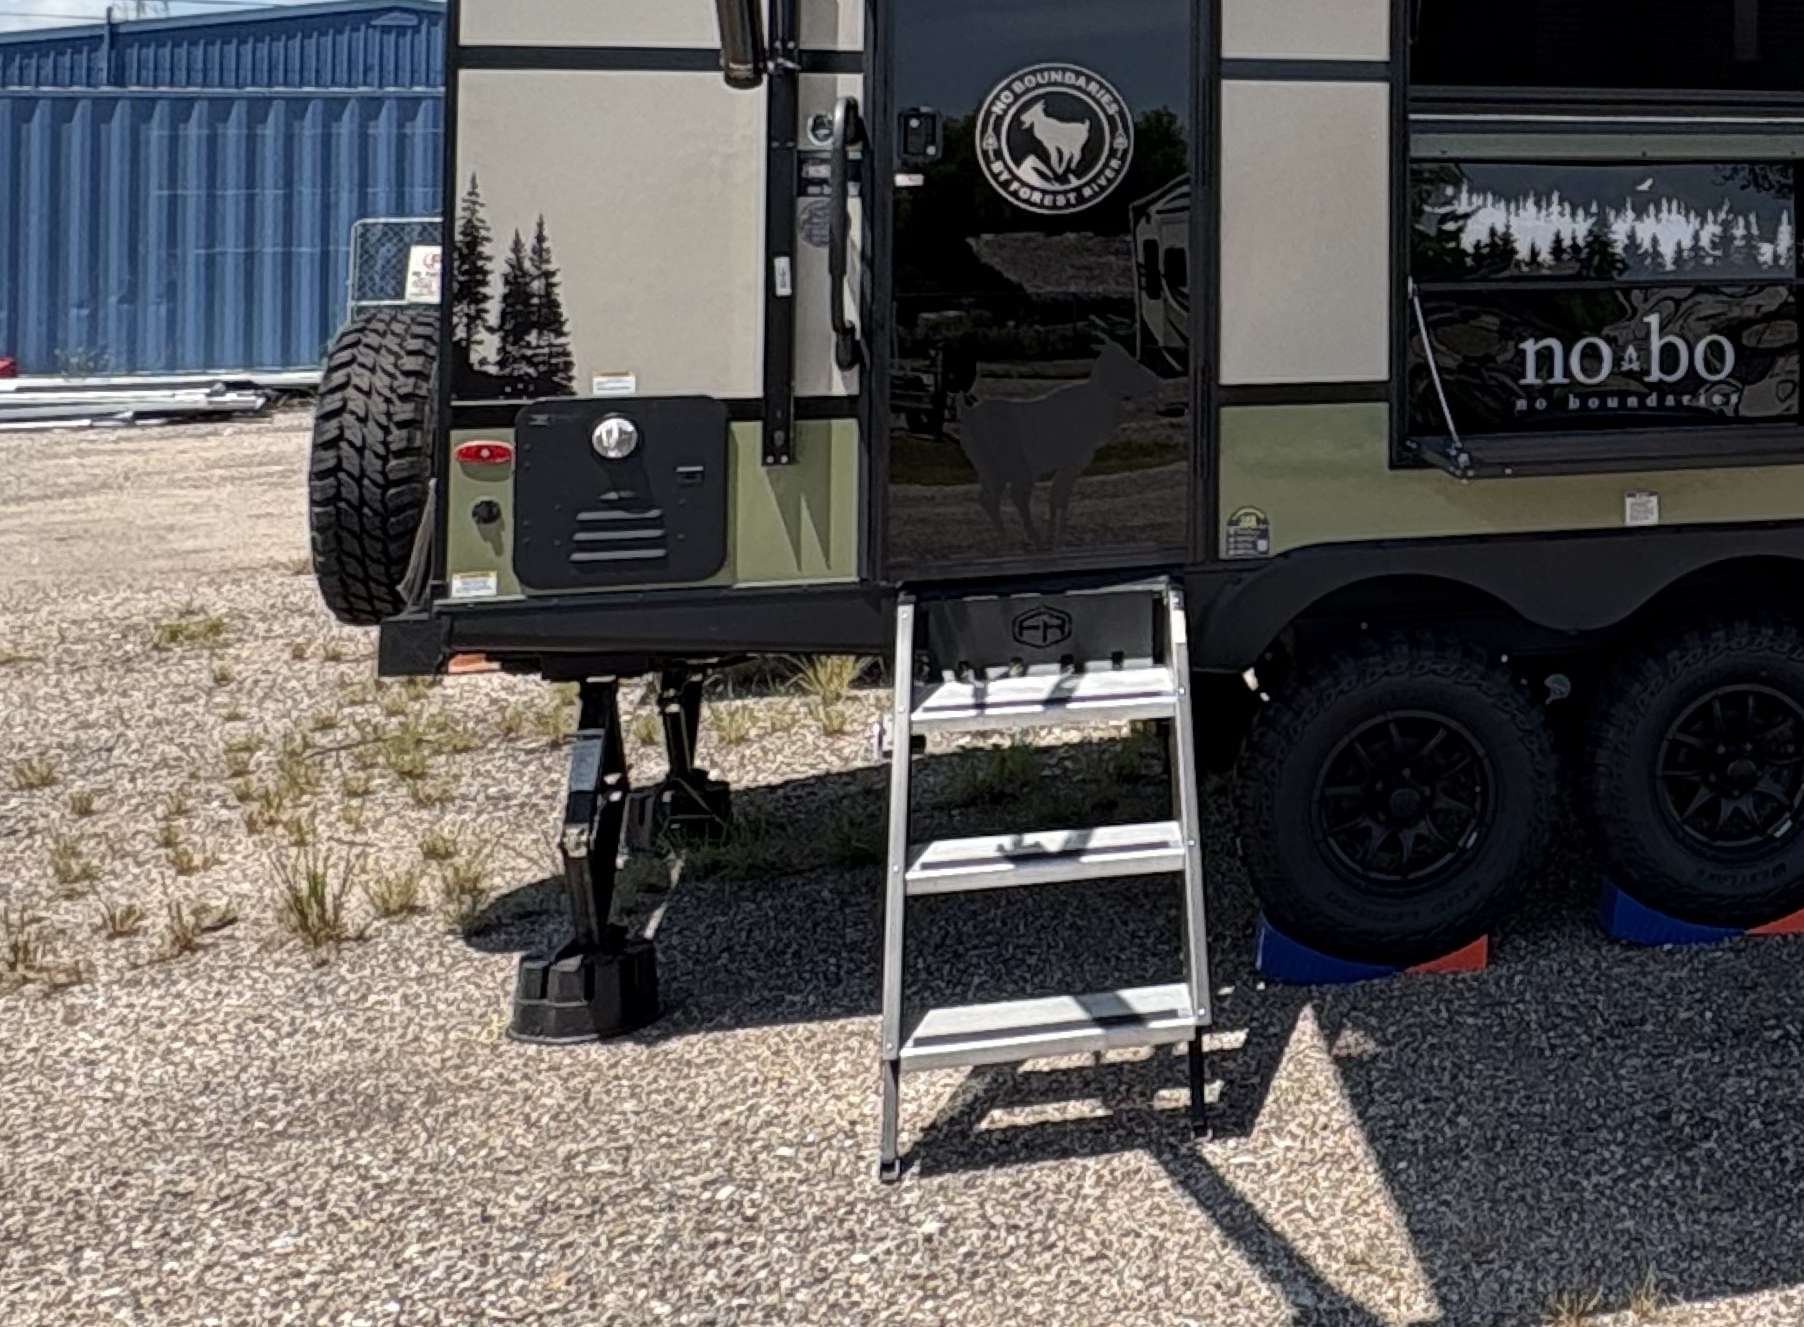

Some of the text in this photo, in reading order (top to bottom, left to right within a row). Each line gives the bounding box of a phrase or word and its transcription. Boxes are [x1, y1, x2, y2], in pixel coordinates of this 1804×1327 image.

[991, 71, 1119, 116] NO BOUNDARIES
[1009, 181, 1077, 207] FOREST
[1082, 159, 1122, 198] RIVER
[1515, 396, 1548, 412] no
